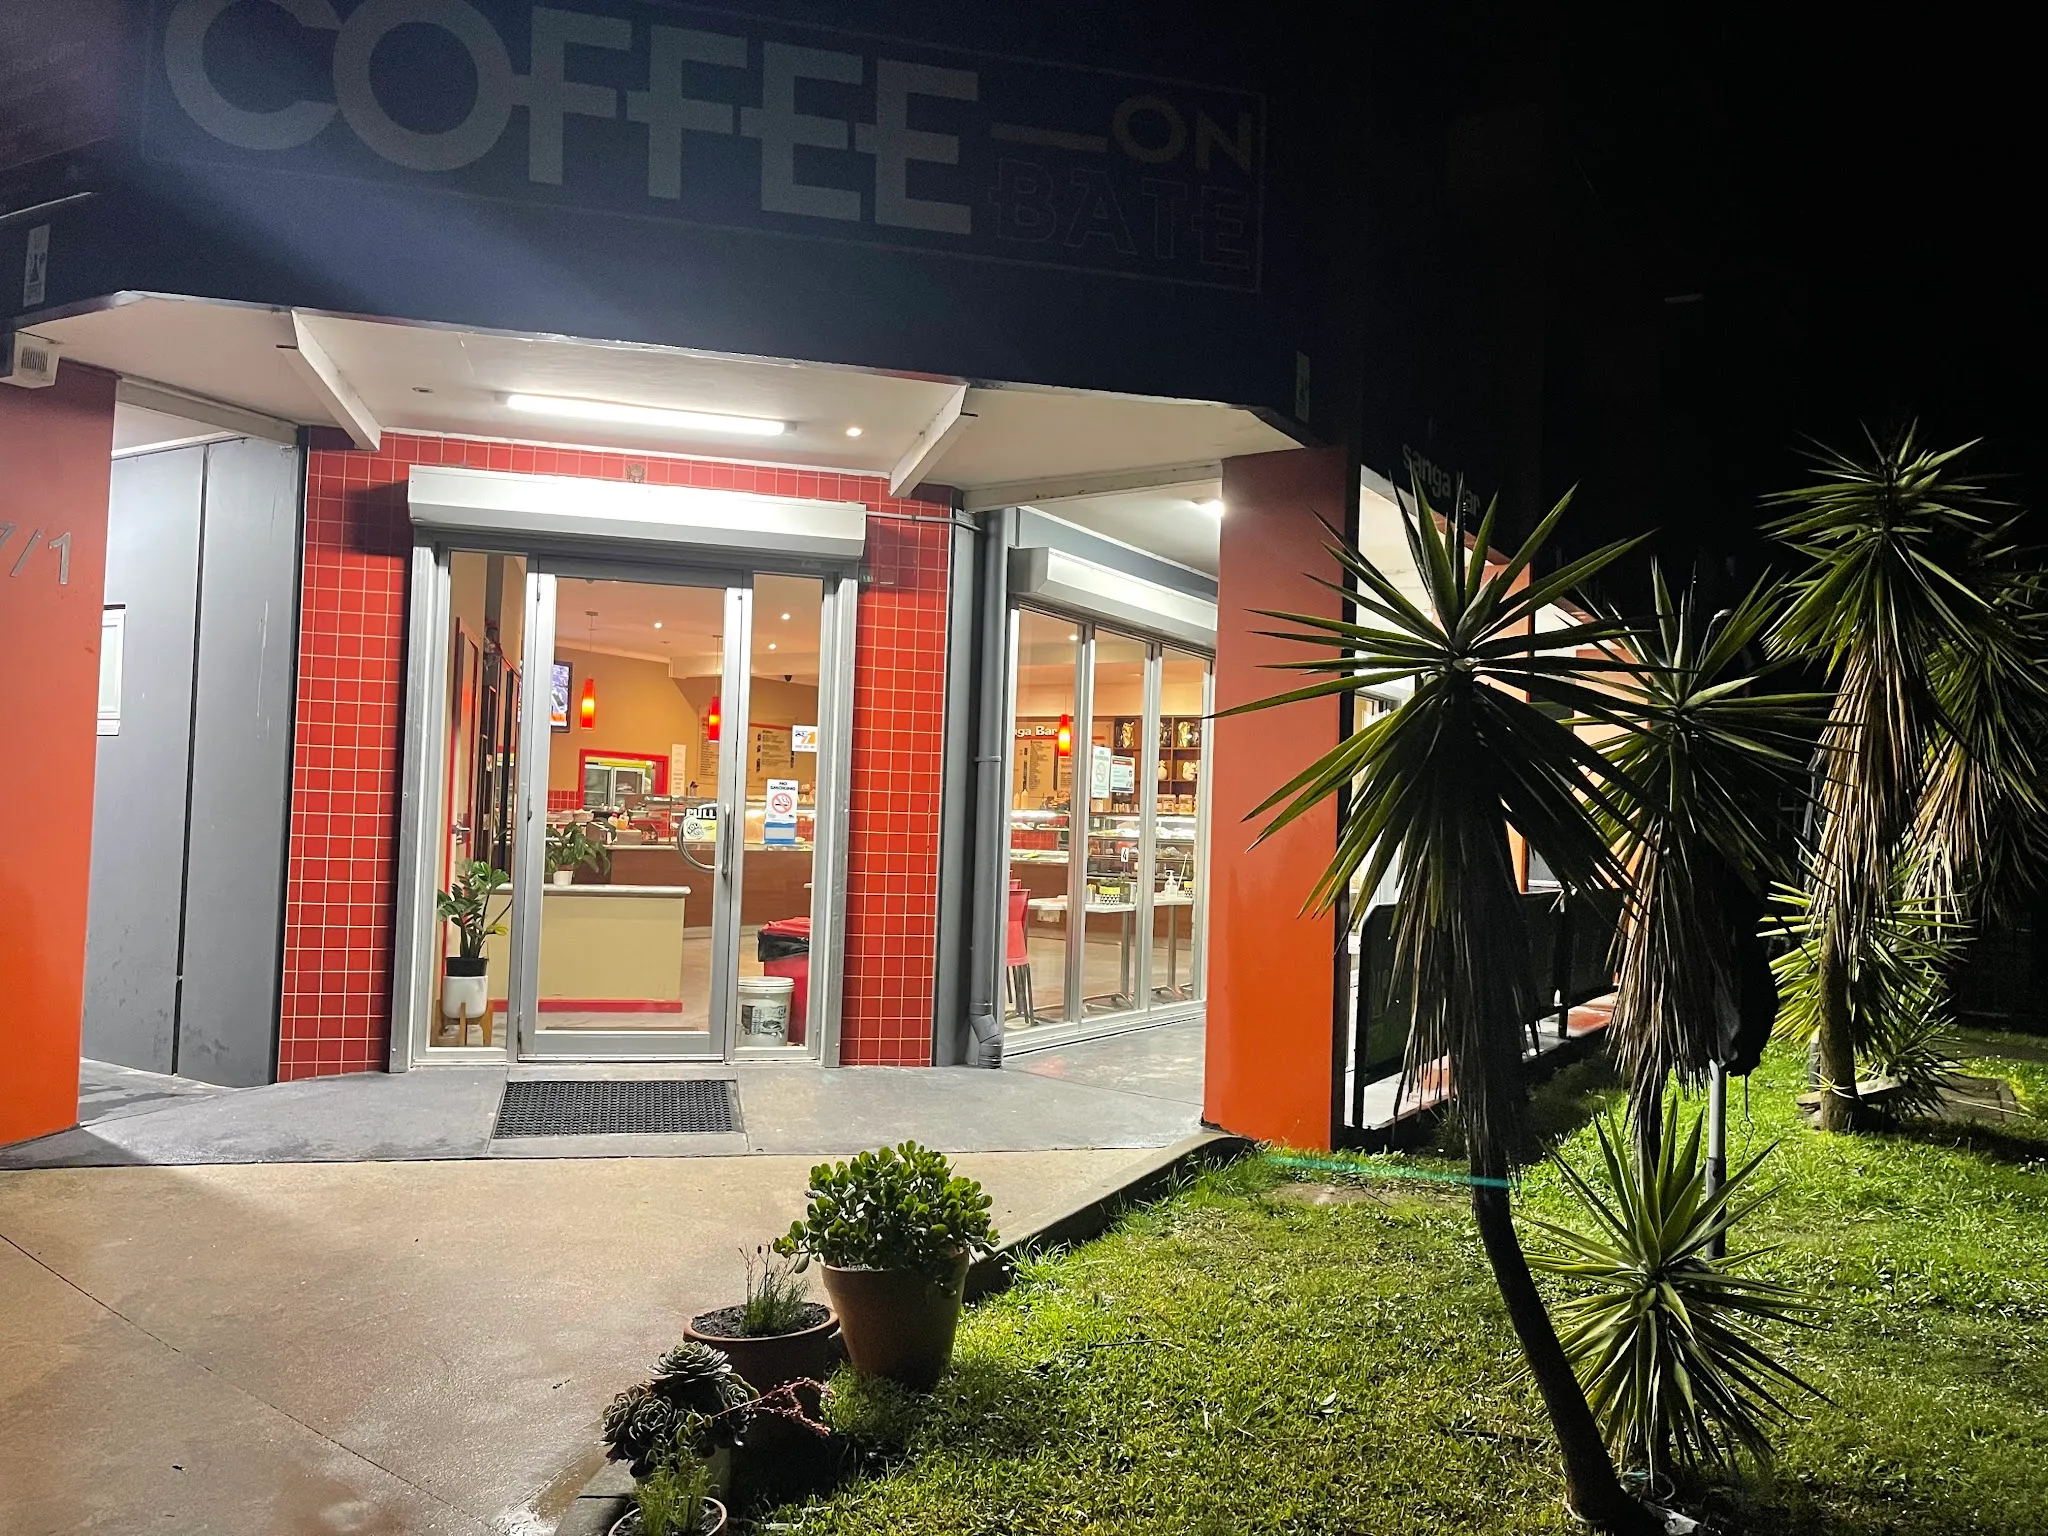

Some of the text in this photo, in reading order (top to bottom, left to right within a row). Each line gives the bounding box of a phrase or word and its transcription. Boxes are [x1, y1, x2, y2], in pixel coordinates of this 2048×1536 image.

[164, 0, 979, 235] COFFEE
[1112, 94, 1254, 174] ON
[987, 157, 1250, 270] BATE
[1035, 725, 1058, 736] Bar
[685, 808, 716, 819] PULL
